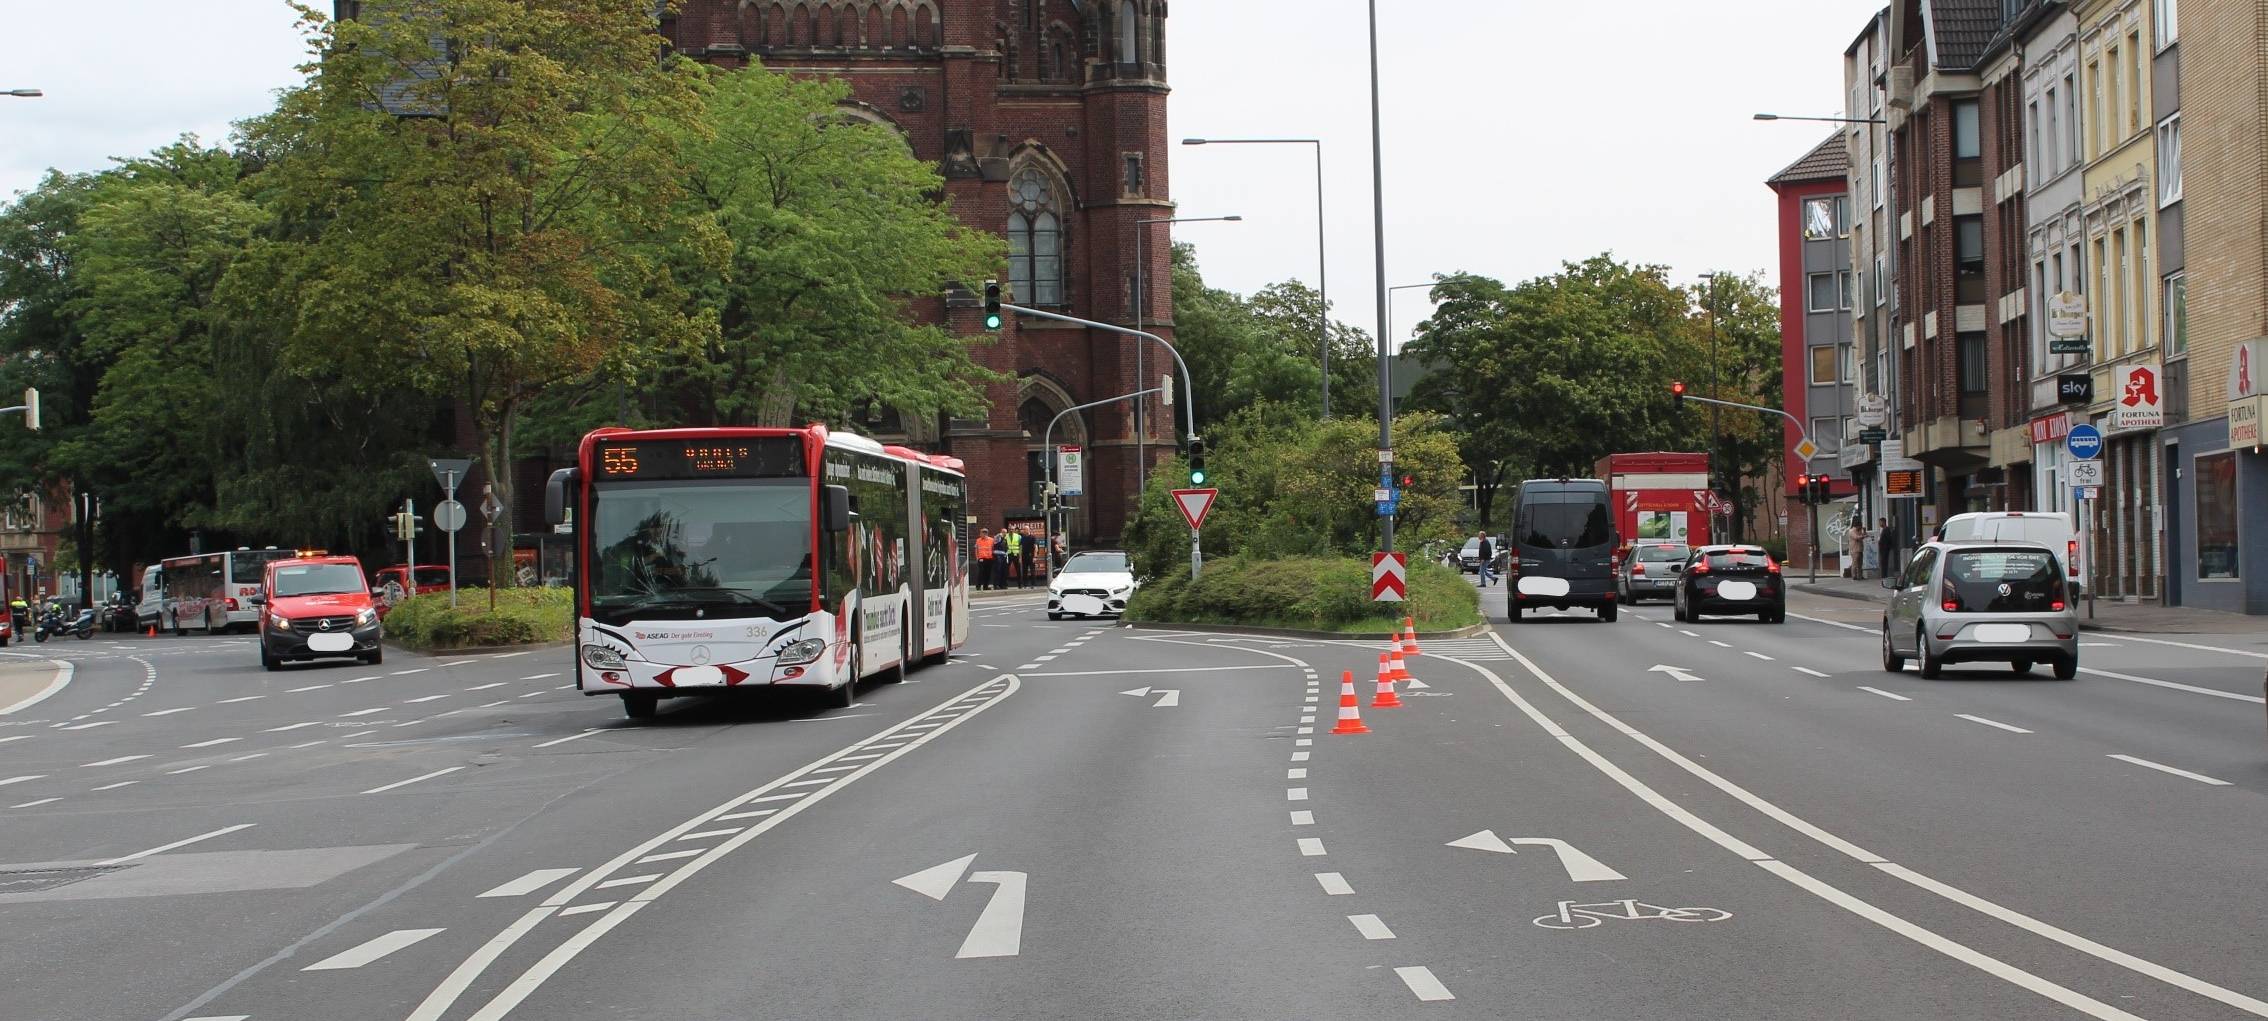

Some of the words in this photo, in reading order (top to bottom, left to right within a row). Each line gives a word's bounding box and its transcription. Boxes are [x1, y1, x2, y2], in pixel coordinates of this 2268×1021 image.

[2062, 381, 2087, 396] sky
[2231, 404, 2255, 423] FORTUNA
[2231, 423, 2256, 442] APOTHEKE
[604, 447, 638, 473] 55
[746, 626, 767, 637] 336
